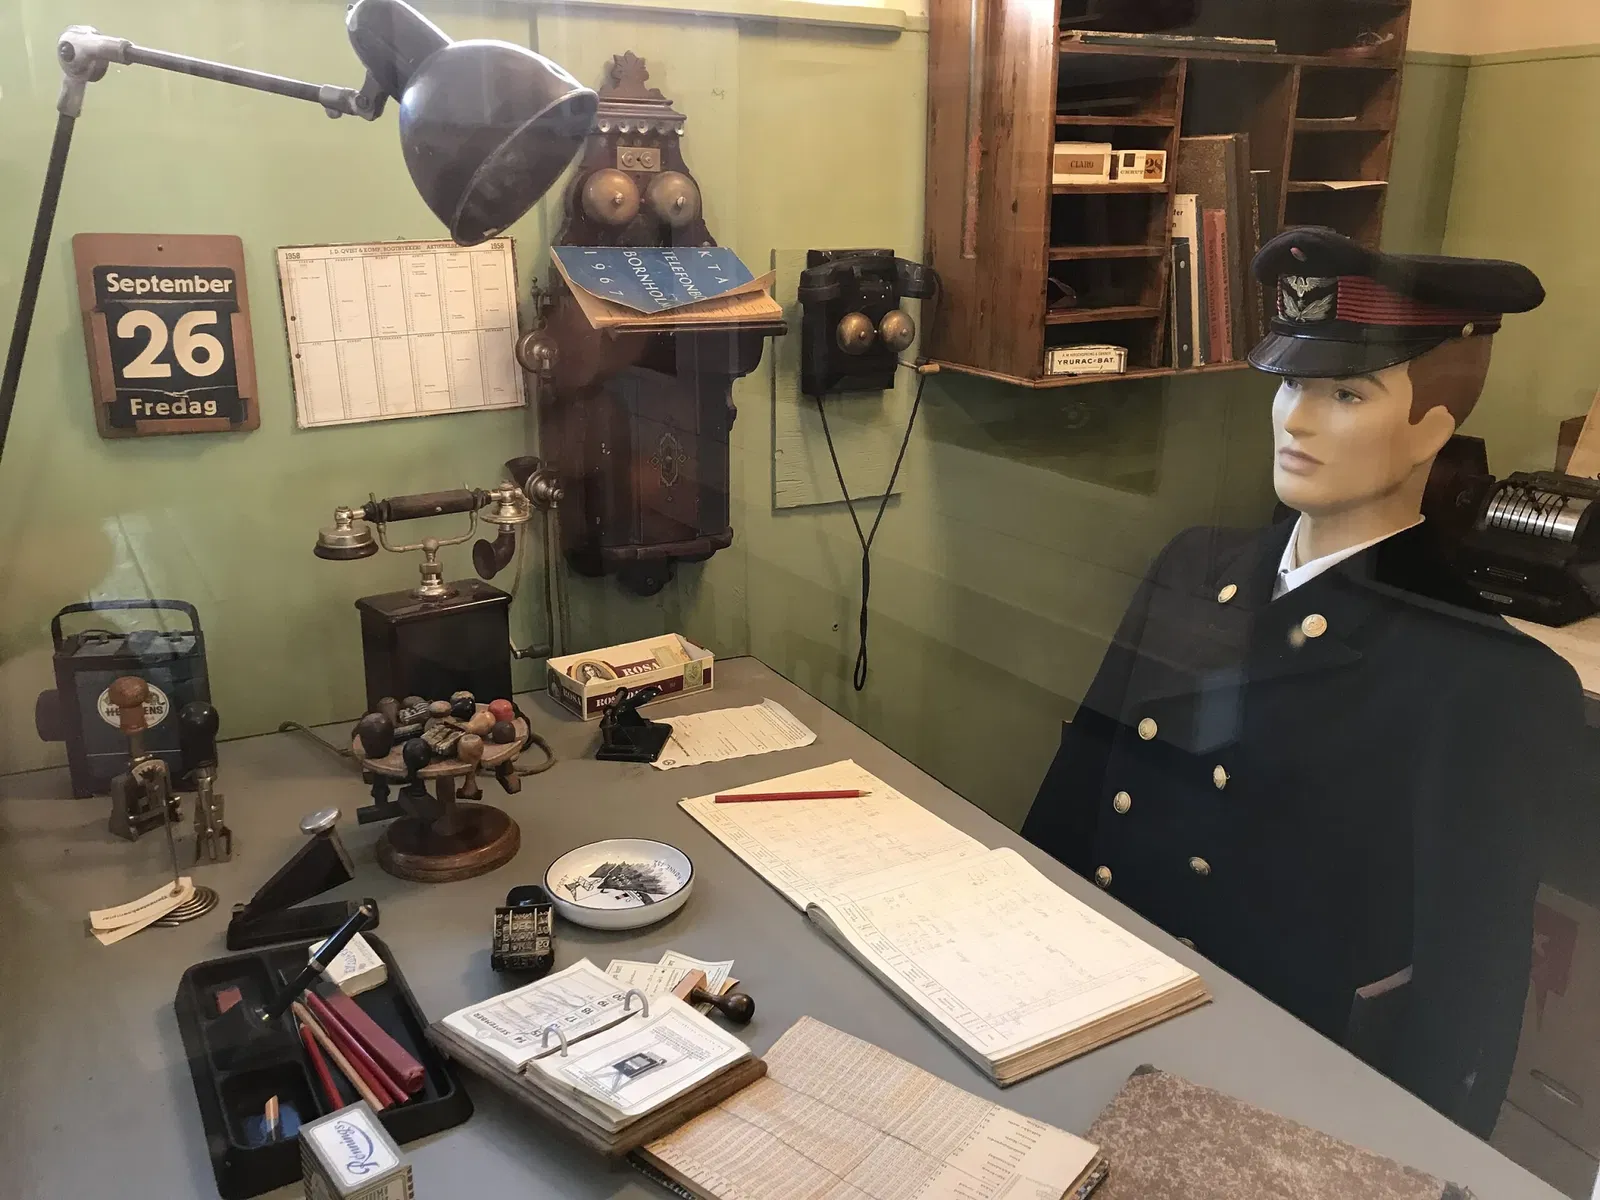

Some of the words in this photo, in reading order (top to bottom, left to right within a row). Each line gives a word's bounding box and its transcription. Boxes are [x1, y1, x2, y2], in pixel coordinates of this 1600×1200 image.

[1070, 160, 1094, 169] CLARO
[490, 242, 505, 250] 1958
[285, 252, 301, 260] 1958
[106, 272, 233, 295] September
[116, 309, 225, 379] 26
[130, 398, 217, 416] Fredag
[622, 661, 660, 677] ROSA
[562, 686, 582, 706] ROSA
[564, 1015, 578, 1023] 17
[581, 1007, 594, 1015] 18
[473, 1012, 511, 1036] SEPTEMBER
